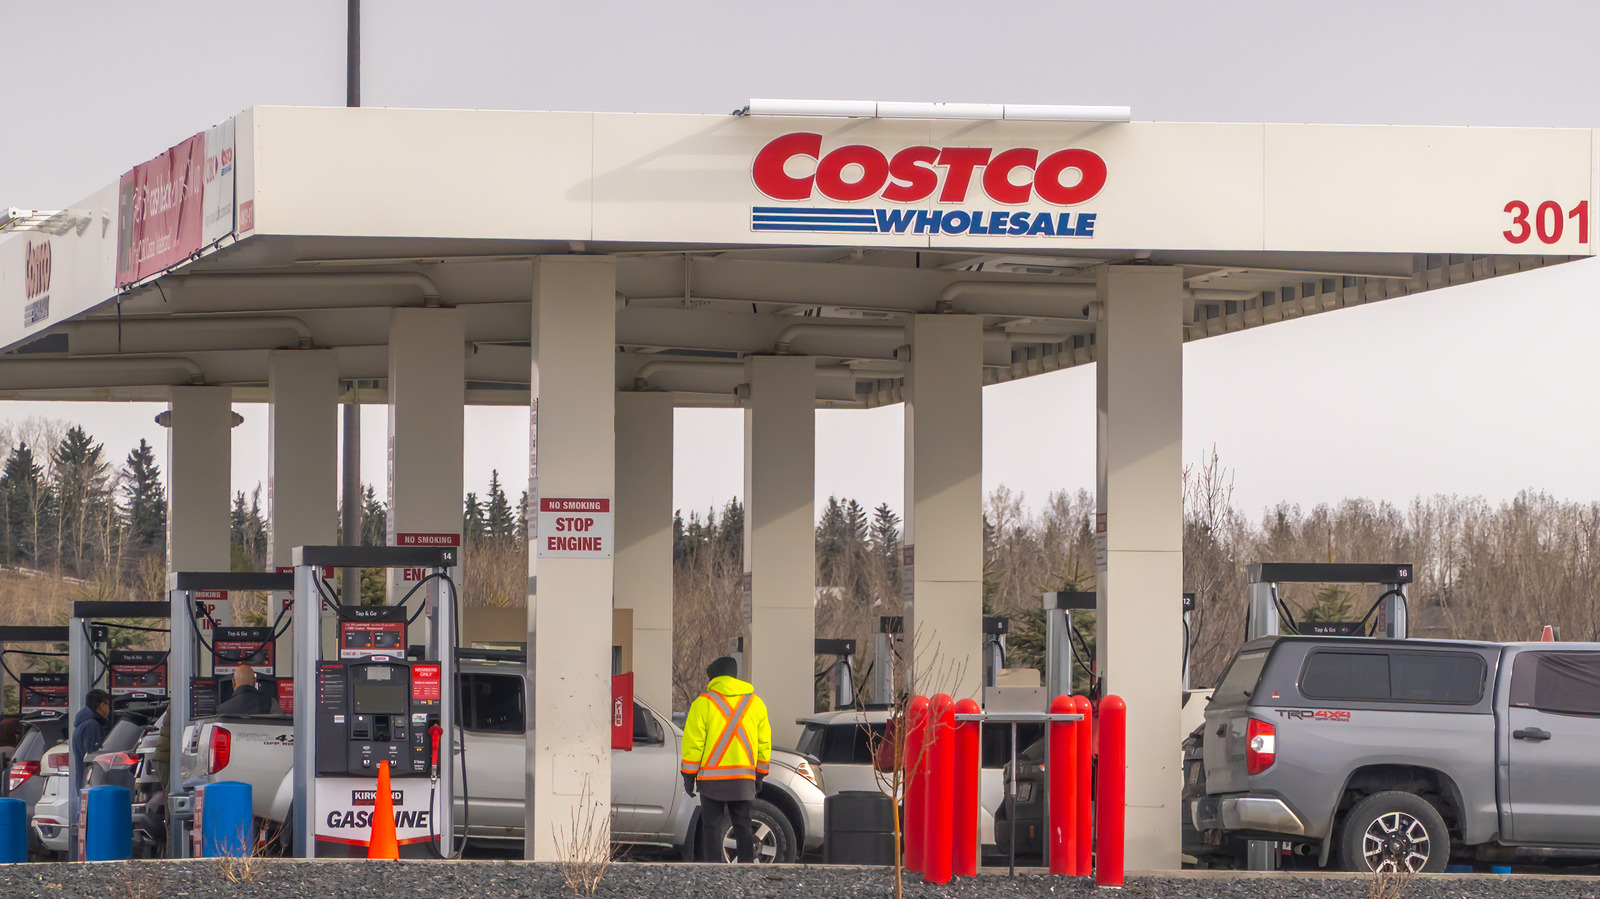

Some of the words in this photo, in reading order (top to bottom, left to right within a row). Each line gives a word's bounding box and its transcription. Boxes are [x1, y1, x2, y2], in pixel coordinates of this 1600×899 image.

[753, 132, 1108, 205] COSTCO
[876, 209, 1097, 237] WHOLESALE
[1502, 200, 1588, 245] 301
[549, 501, 560, 509] NO
[562, 501, 601, 509] SMOKING
[555, 517, 594, 532] STOP
[417, 536, 452, 544] SMOKING
[547, 536, 602, 551] ENGINE
[443, 552, 452, 560] 14
[1275, 710, 1314, 720] TRD
